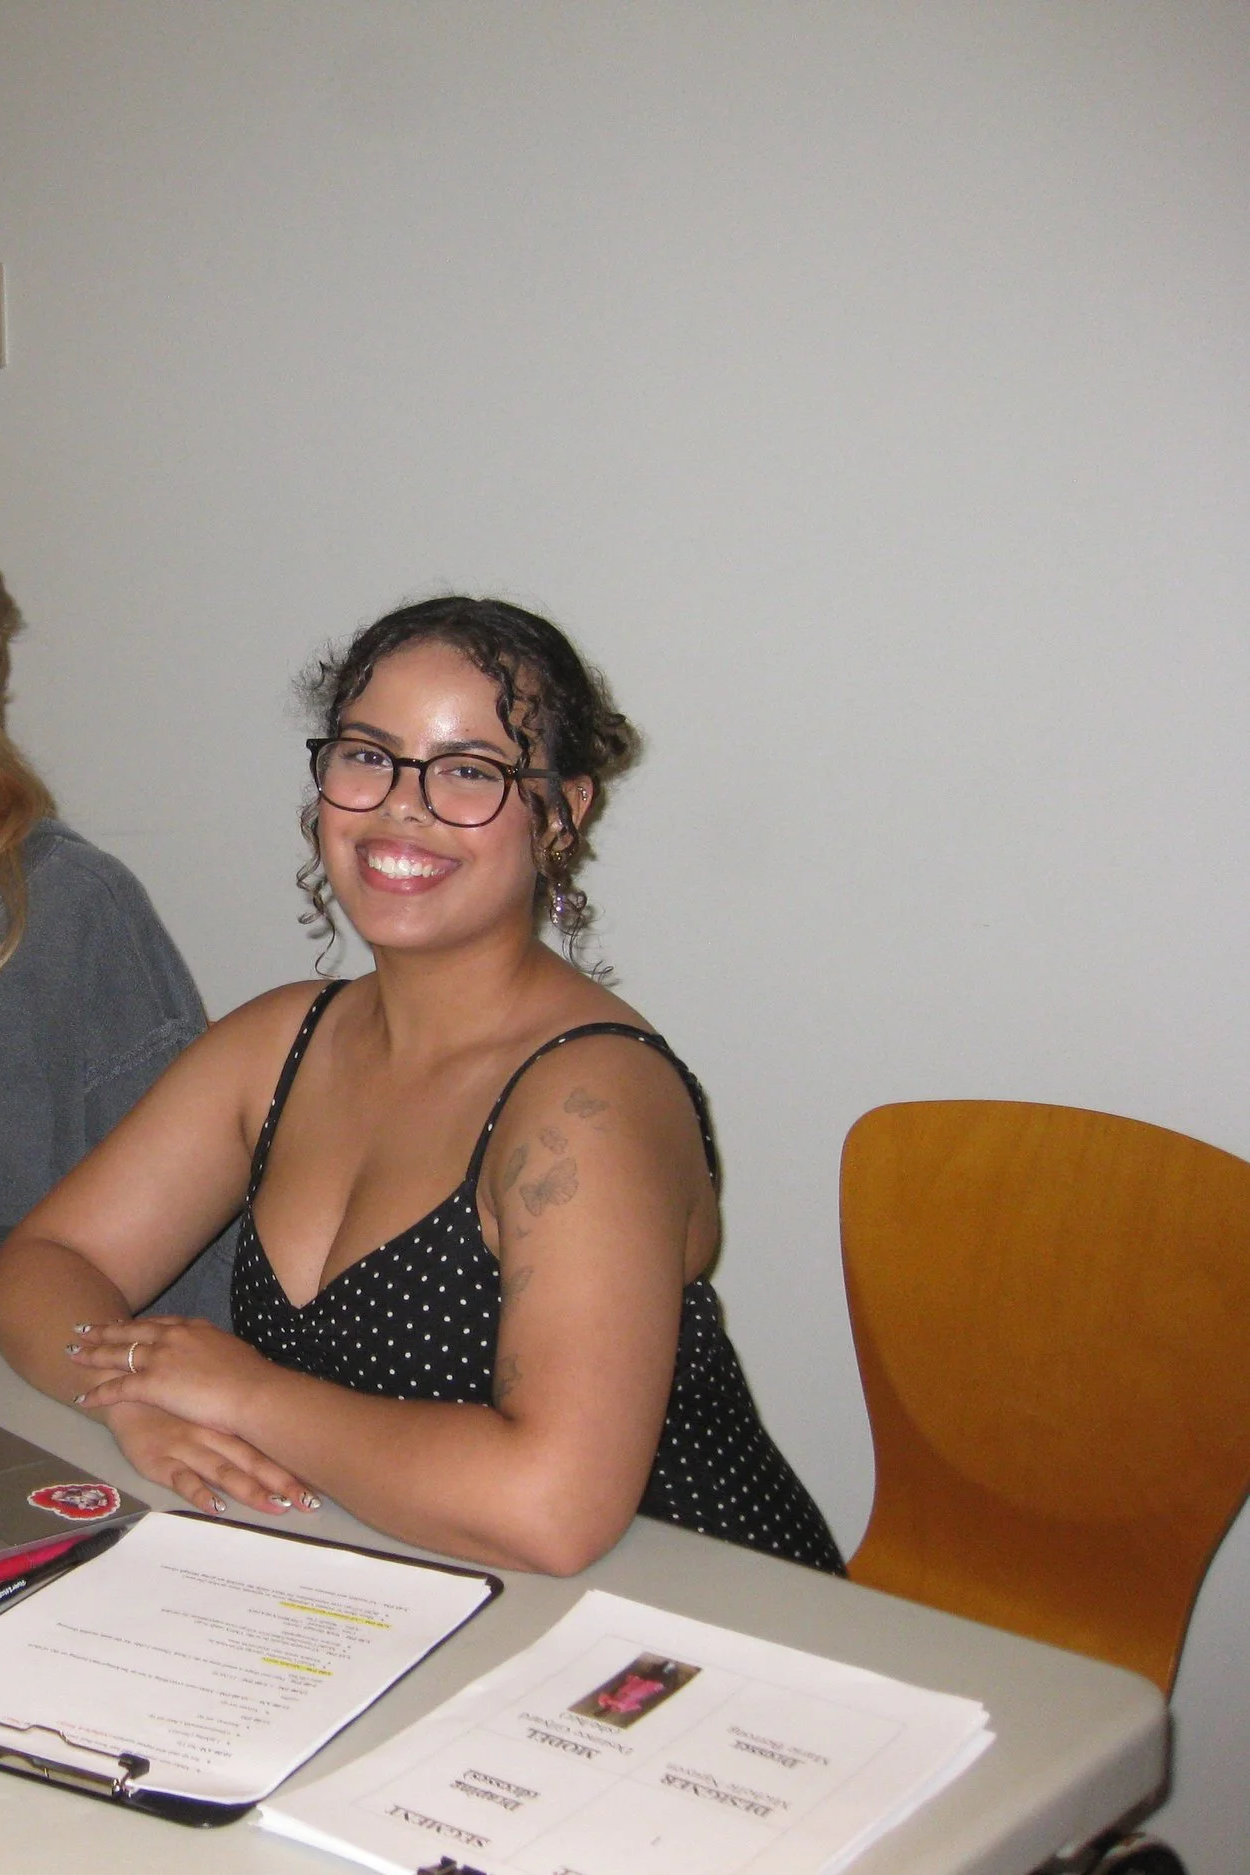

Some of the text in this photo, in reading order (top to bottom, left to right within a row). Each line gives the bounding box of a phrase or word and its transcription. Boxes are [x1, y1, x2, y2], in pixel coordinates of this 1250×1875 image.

[526, 1727, 601, 1760] MODEL
[661, 1773, 774, 1818] DESIGNER
[386, 1804, 491, 1848] SEGMENT
